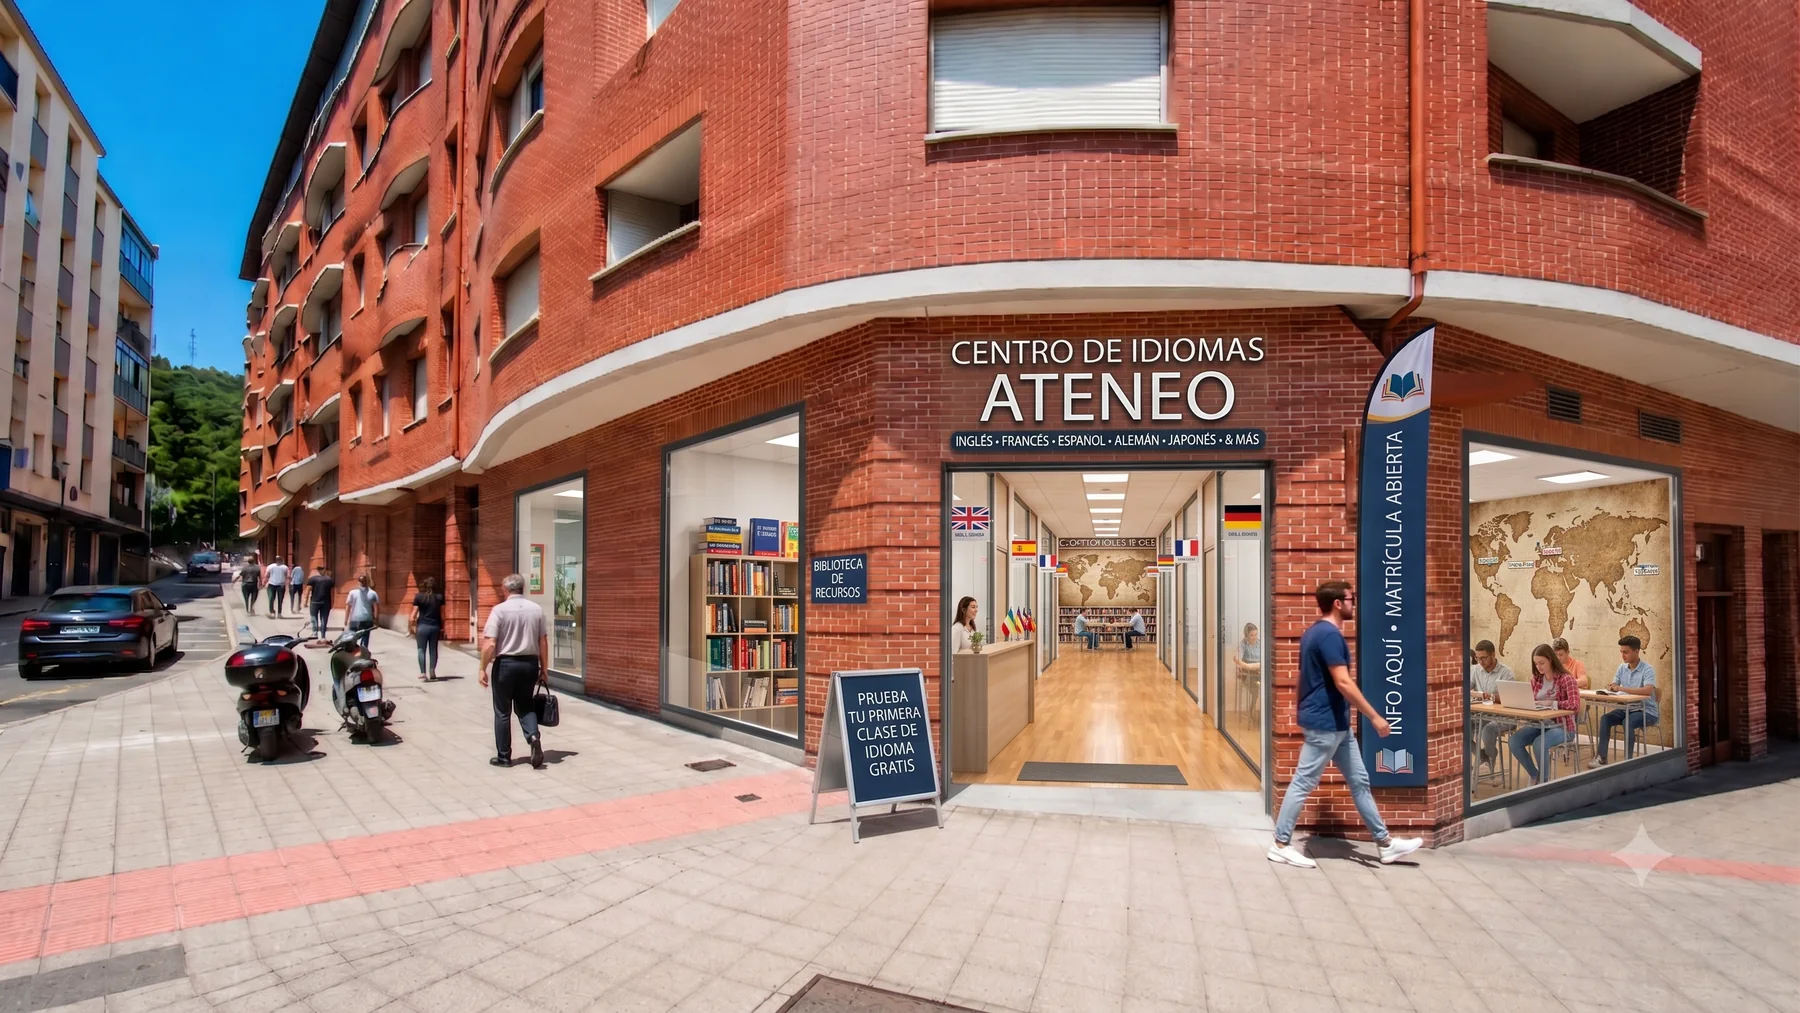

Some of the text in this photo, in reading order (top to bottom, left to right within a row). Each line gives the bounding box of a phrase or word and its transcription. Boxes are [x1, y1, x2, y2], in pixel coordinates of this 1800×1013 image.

[951, 337, 1265, 365] CENTRO DE IDIOMAS
[979, 370, 1236, 422] ATENEO
[955, 433, 993, 447] INGLÉS
[1001, 433, 1050, 447] FRANCÉS
[1114, 432, 1160, 446] ALEMÁN
[1167, 431, 1217, 446] JAPONÉS
[1224, 434, 1234, 445] &
[1235, 431, 1260, 445] MÁS
[813, 558, 864, 571] BIBLIOTECA
[831, 573, 844, 584] DE
[1381, 430, 1404, 735] INFO AQUÍ MATRÍCULA ABIERTA
[815, 586, 861, 598] RECURSOS
[857, 690, 909, 706] PRUEBA
[847, 706, 922, 724] TU PRIMERA
[856, 723, 919, 741] CLASE DE
[864, 741, 915, 759] IDIOMA
[869, 758, 915, 777] GRATIS
